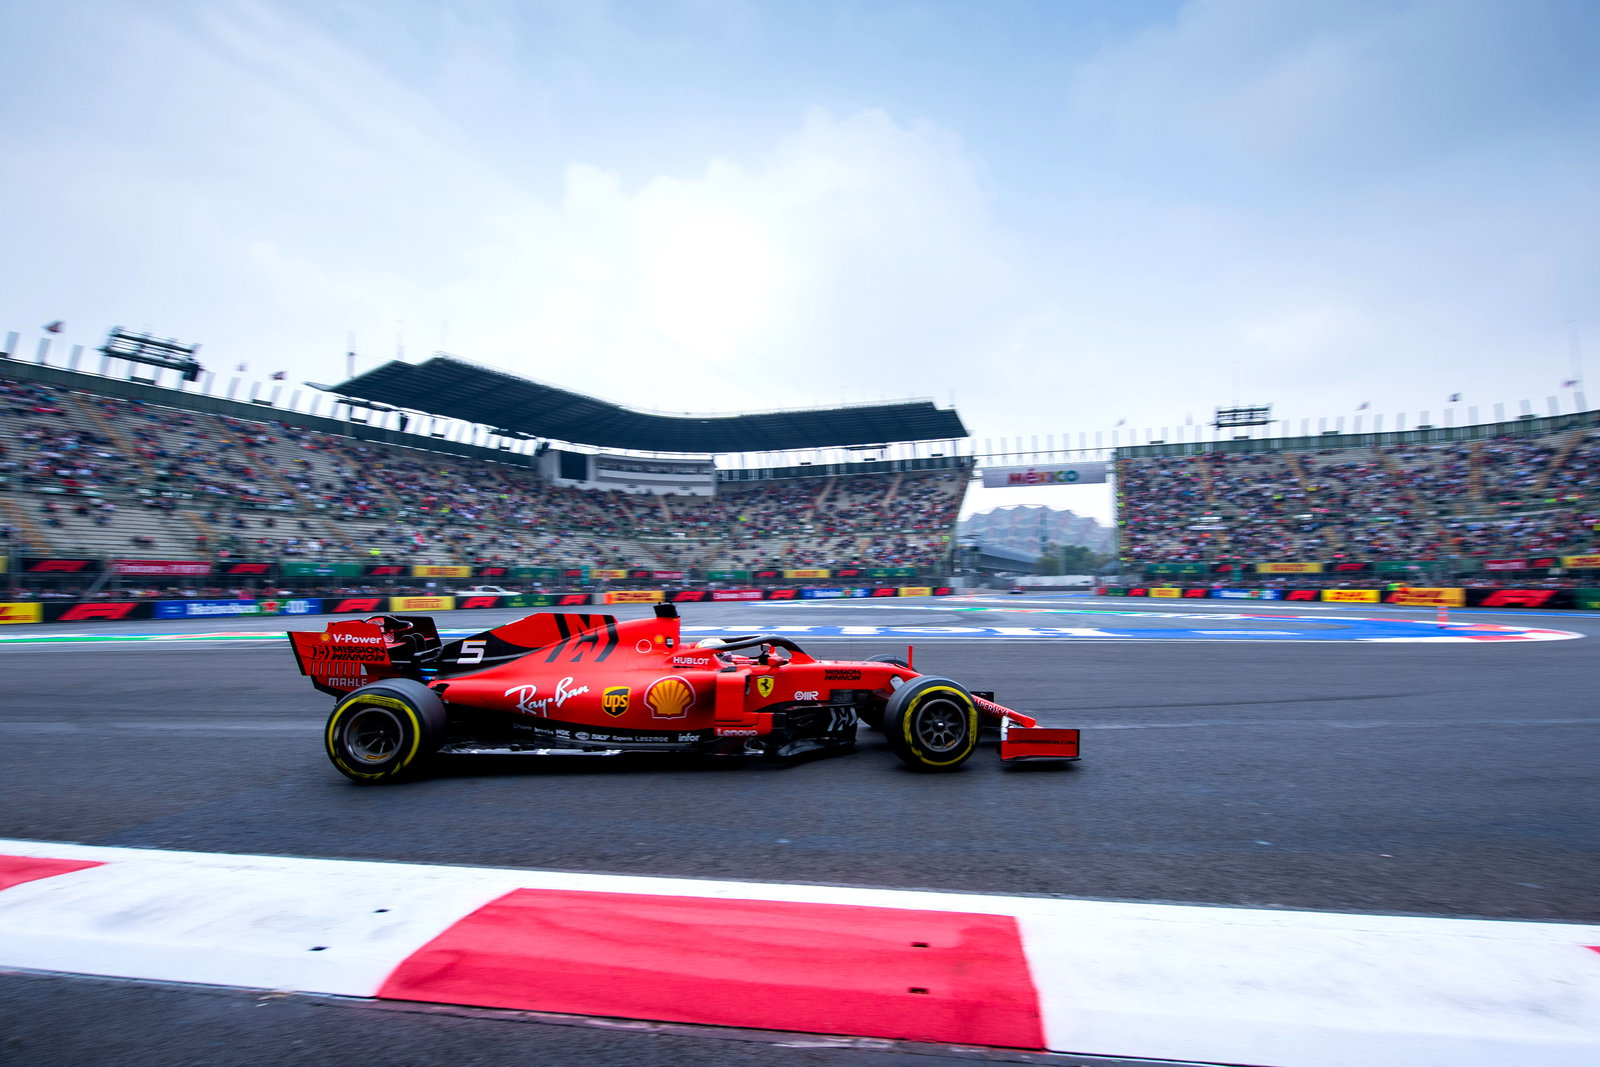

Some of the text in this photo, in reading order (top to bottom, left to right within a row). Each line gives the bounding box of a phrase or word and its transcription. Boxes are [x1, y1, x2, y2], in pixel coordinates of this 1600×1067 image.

[333, 633, 382, 645] V-Power
[331, 645, 386, 654] MISSION
[457, 640, 487, 664] 5
[673, 657, 710, 665] HUBLOT
[328, 678, 367, 687] MAHLE
[717, 728, 758, 737] Lenovo
[678, 733, 700, 742] infor
